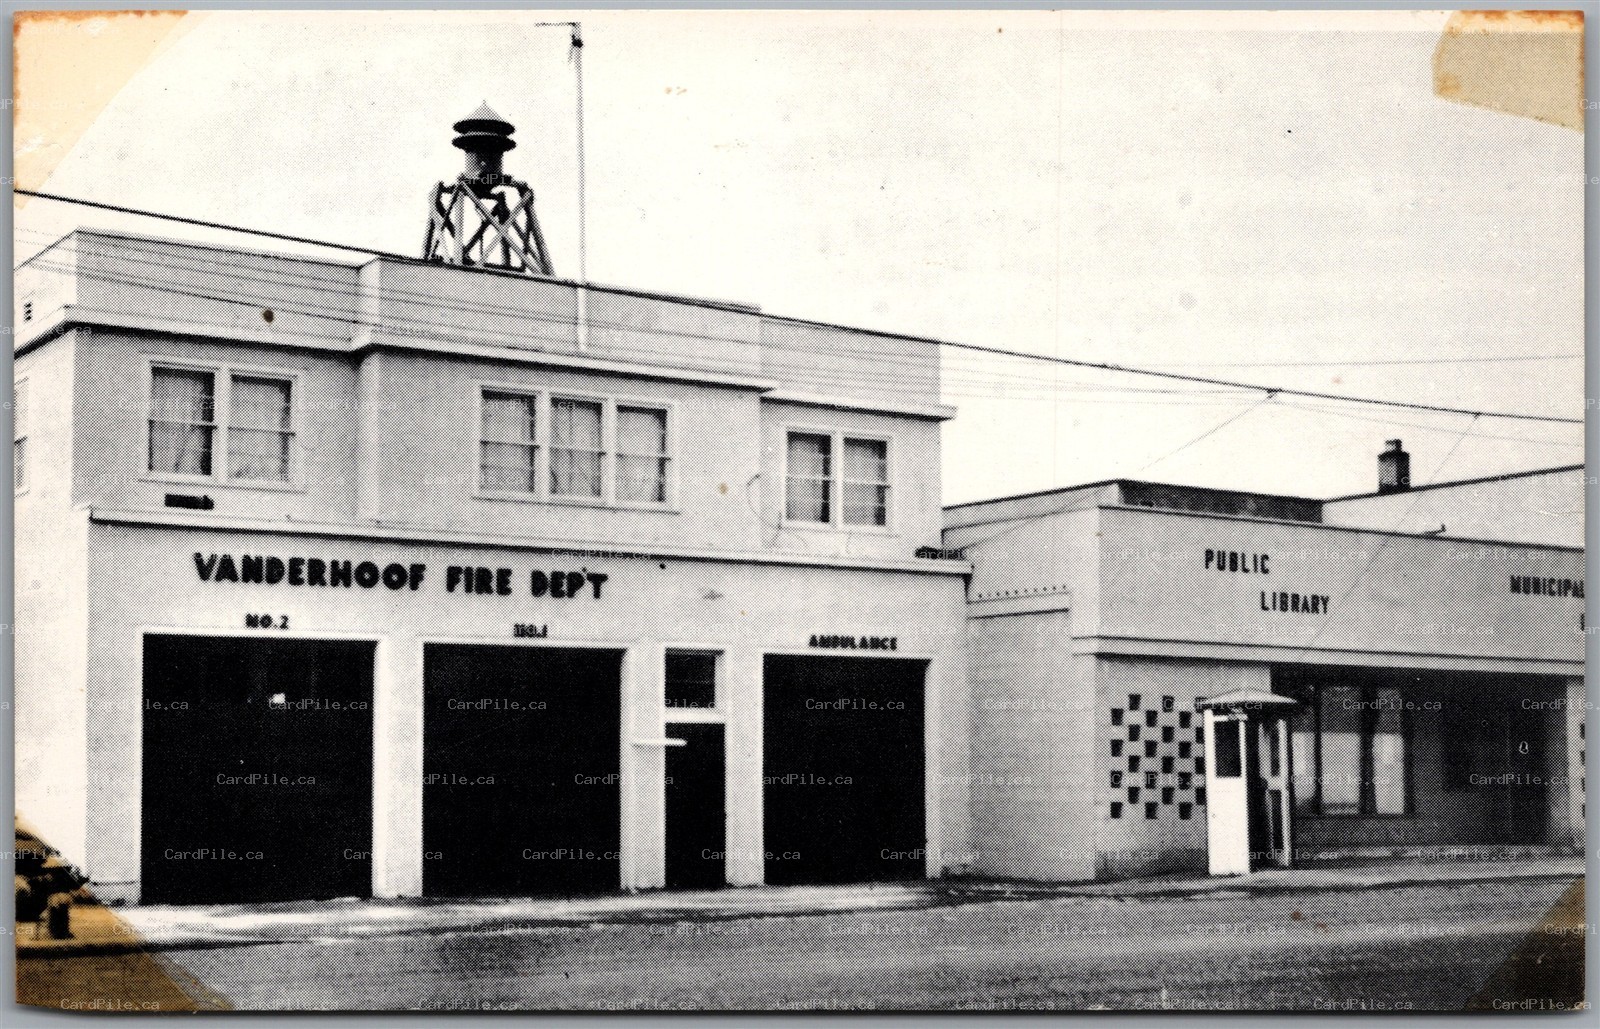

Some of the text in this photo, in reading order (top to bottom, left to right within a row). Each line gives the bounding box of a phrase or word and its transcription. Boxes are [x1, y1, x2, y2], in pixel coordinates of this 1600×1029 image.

[1204, 549, 1270, 574] PUBLIC
[193, 552, 426, 591] VANDERHOOF
[446, 566, 512, 596] FIRE
[1260, 591, 1330, 615] LIBRARY
[245, 613, 289, 630] NO.2
